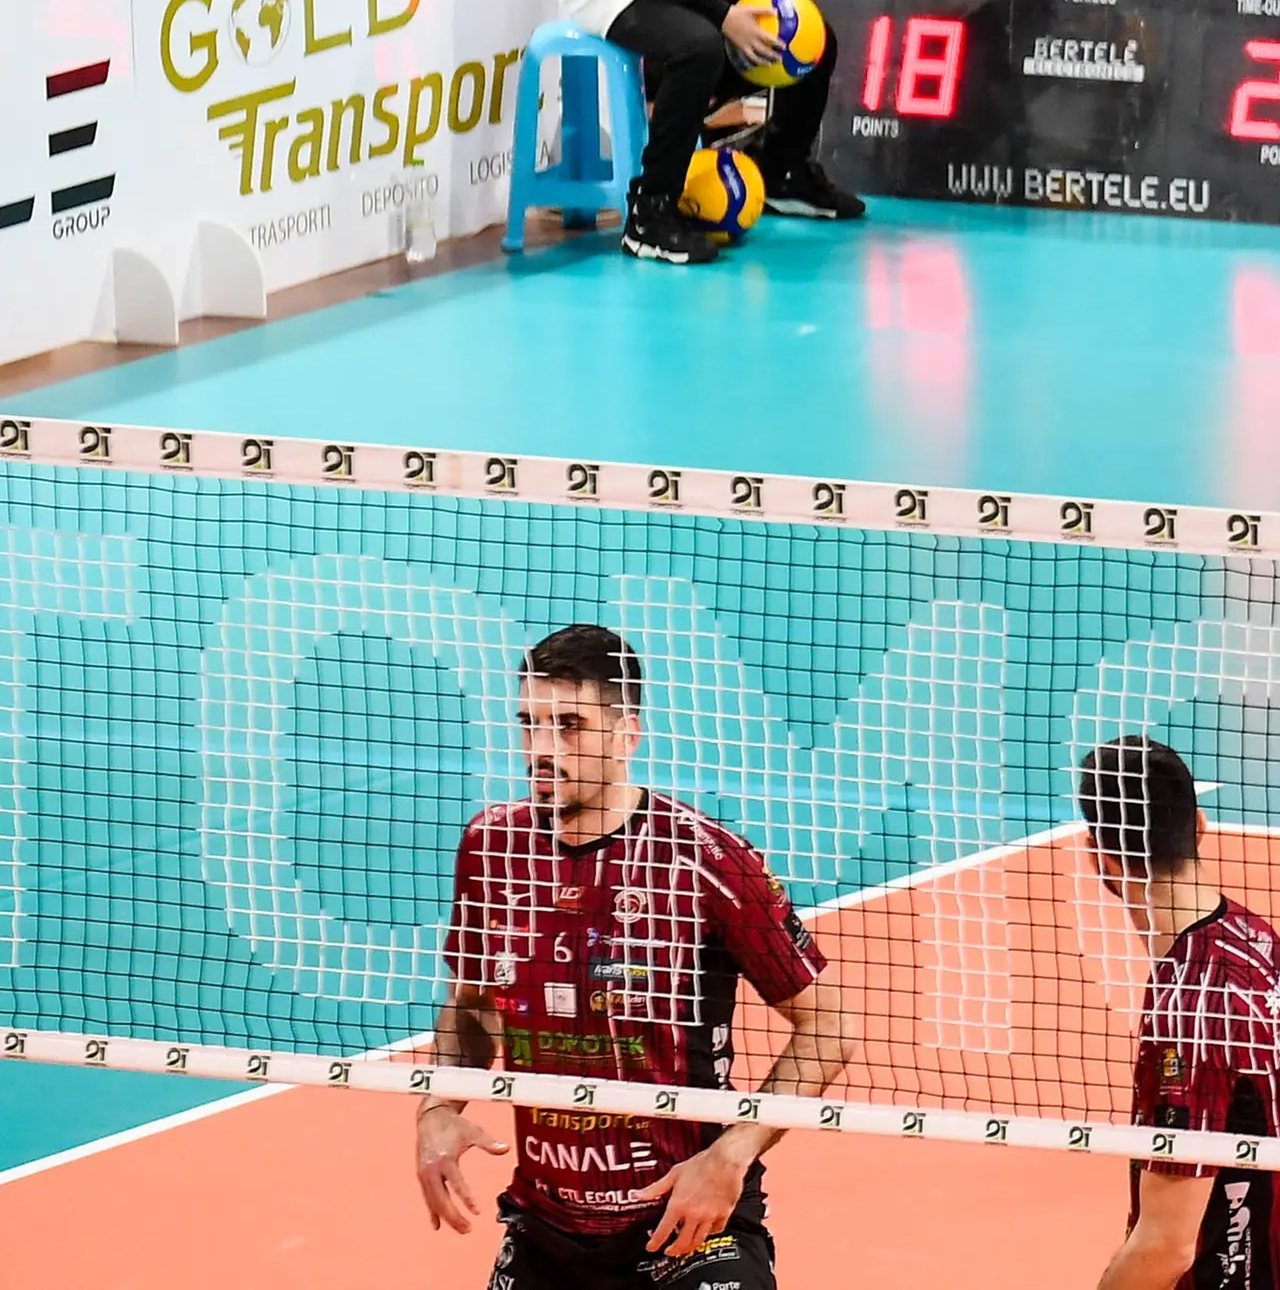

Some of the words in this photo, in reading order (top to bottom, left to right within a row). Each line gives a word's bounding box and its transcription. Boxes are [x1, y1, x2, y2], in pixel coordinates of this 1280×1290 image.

[861, 15, 965, 117] 18
[207, 46, 528, 197] Transpor
[852, 116, 899, 139] POINTS
[52, 206, 111, 241] GROUP
[249, 204, 332, 249] TRASPORTI
[361, 173, 439, 218] DEPOSITO
[554, 932, 573, 963] 6
[525, 1135, 658, 1172] CANALE
